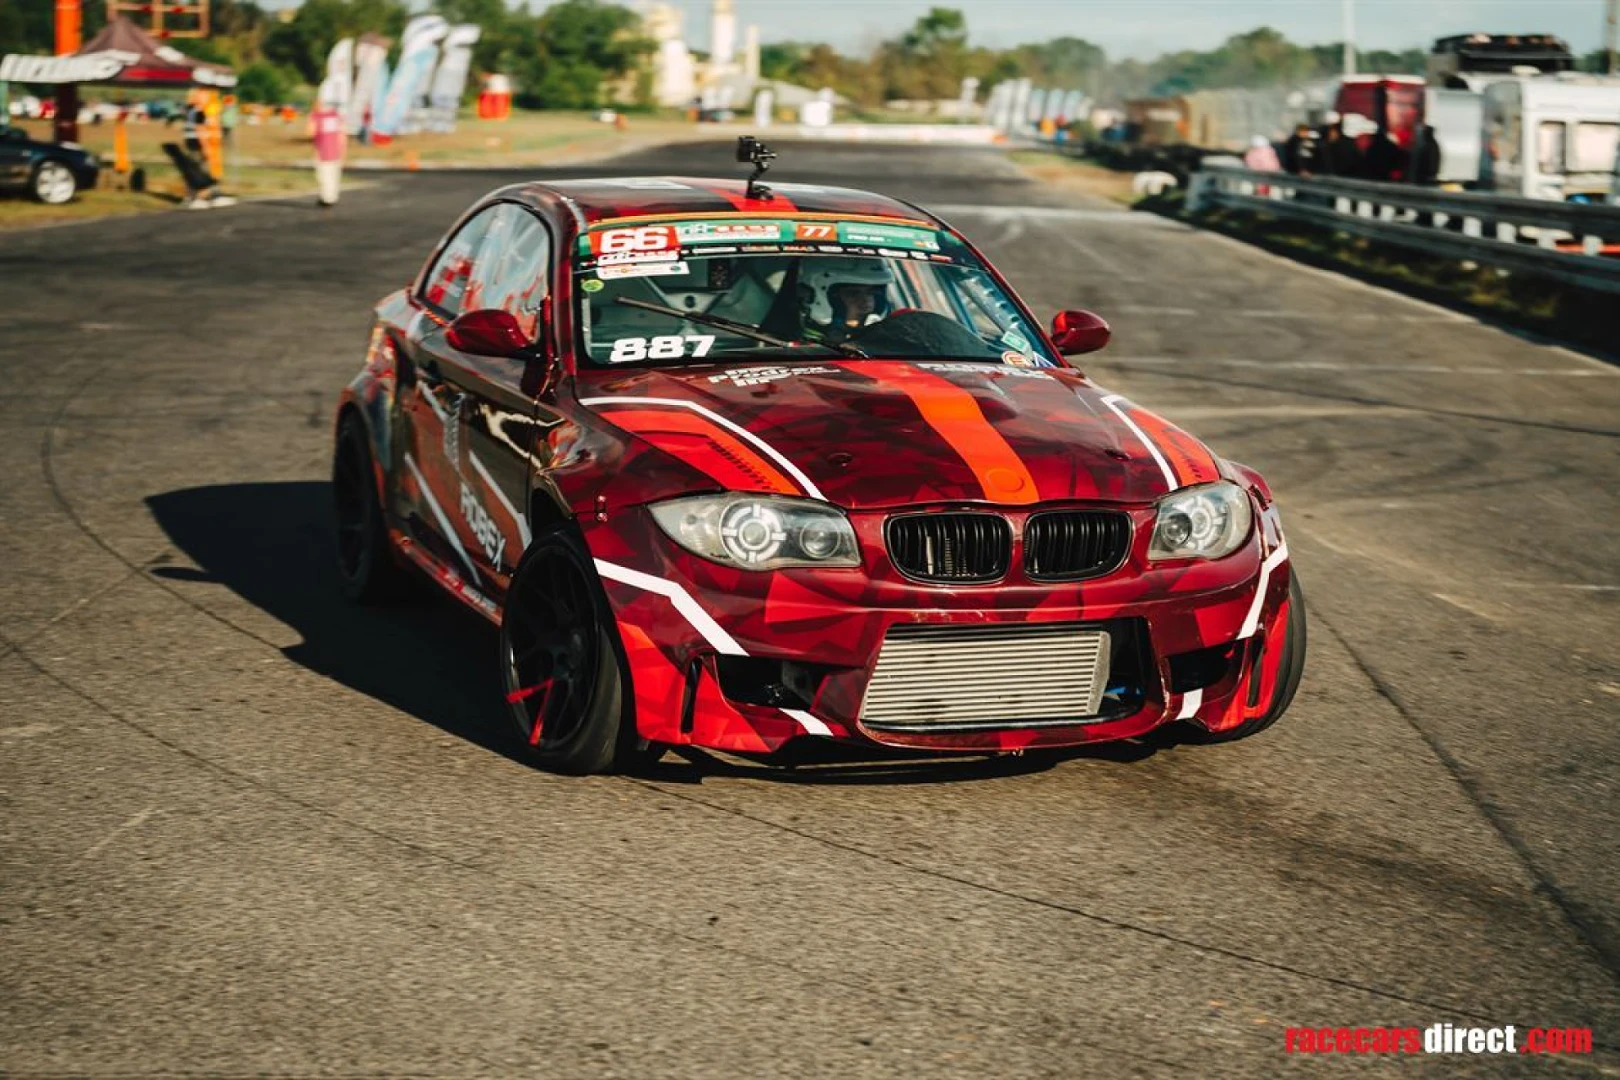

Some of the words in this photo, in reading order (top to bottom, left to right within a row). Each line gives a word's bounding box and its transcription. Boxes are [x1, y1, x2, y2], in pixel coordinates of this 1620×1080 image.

[600, 226, 669, 253] 66
[802, 225, 833, 237] 77
[609, 334, 716, 363] 887
